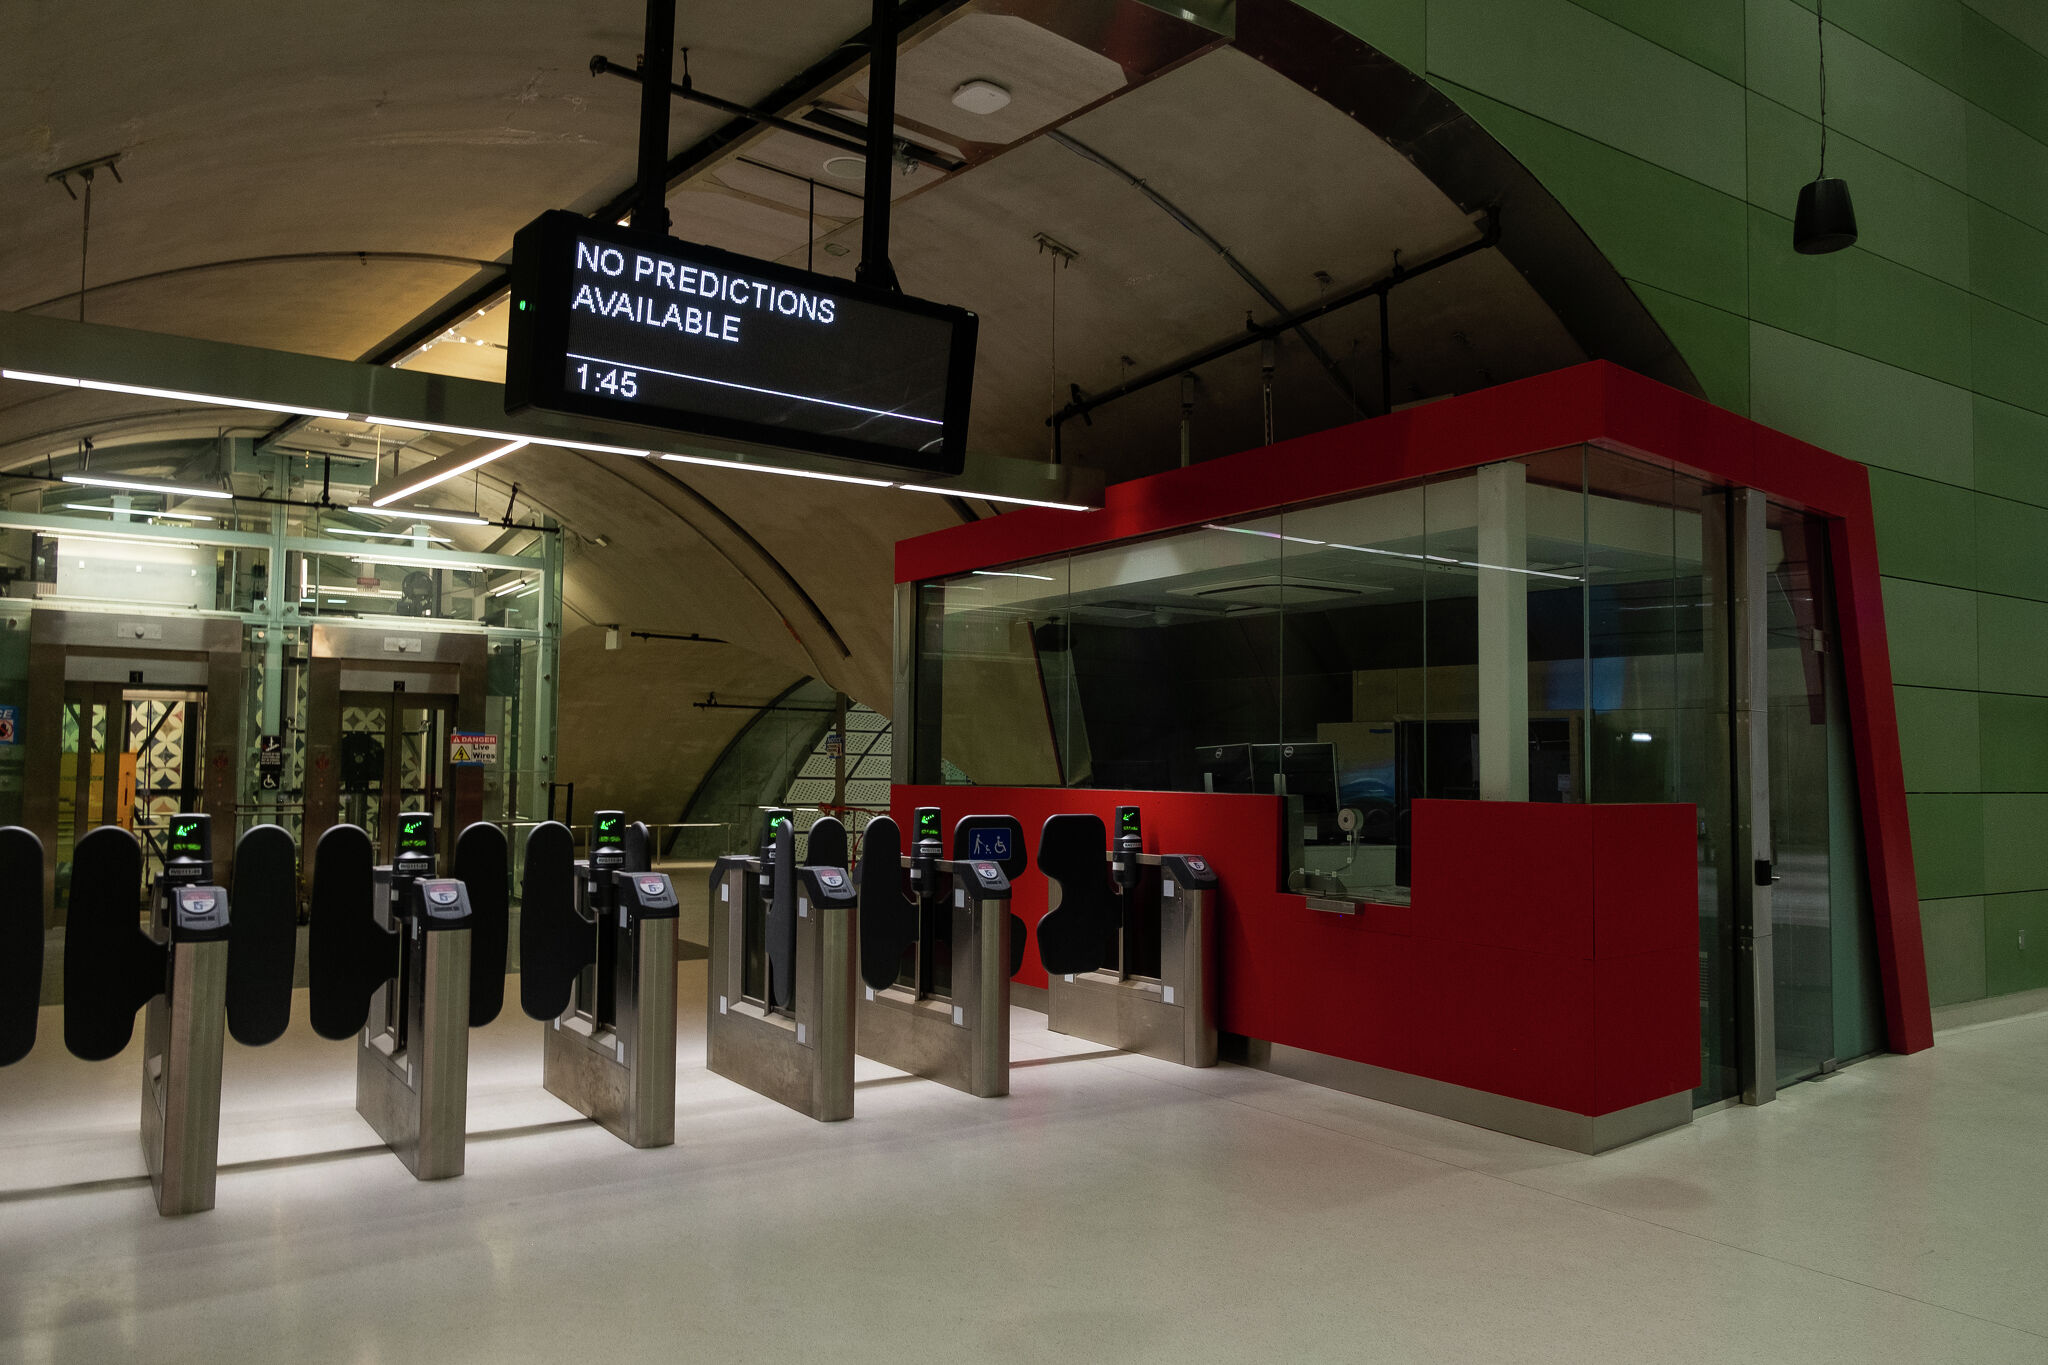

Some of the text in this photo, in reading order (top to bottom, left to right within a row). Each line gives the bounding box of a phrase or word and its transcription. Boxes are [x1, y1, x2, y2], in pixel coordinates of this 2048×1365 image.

[577, 241, 836, 324] NO PREDICTIONS
[572, 284, 741, 342] AVAILABLE
[577, 363, 637, 397] 1:45
